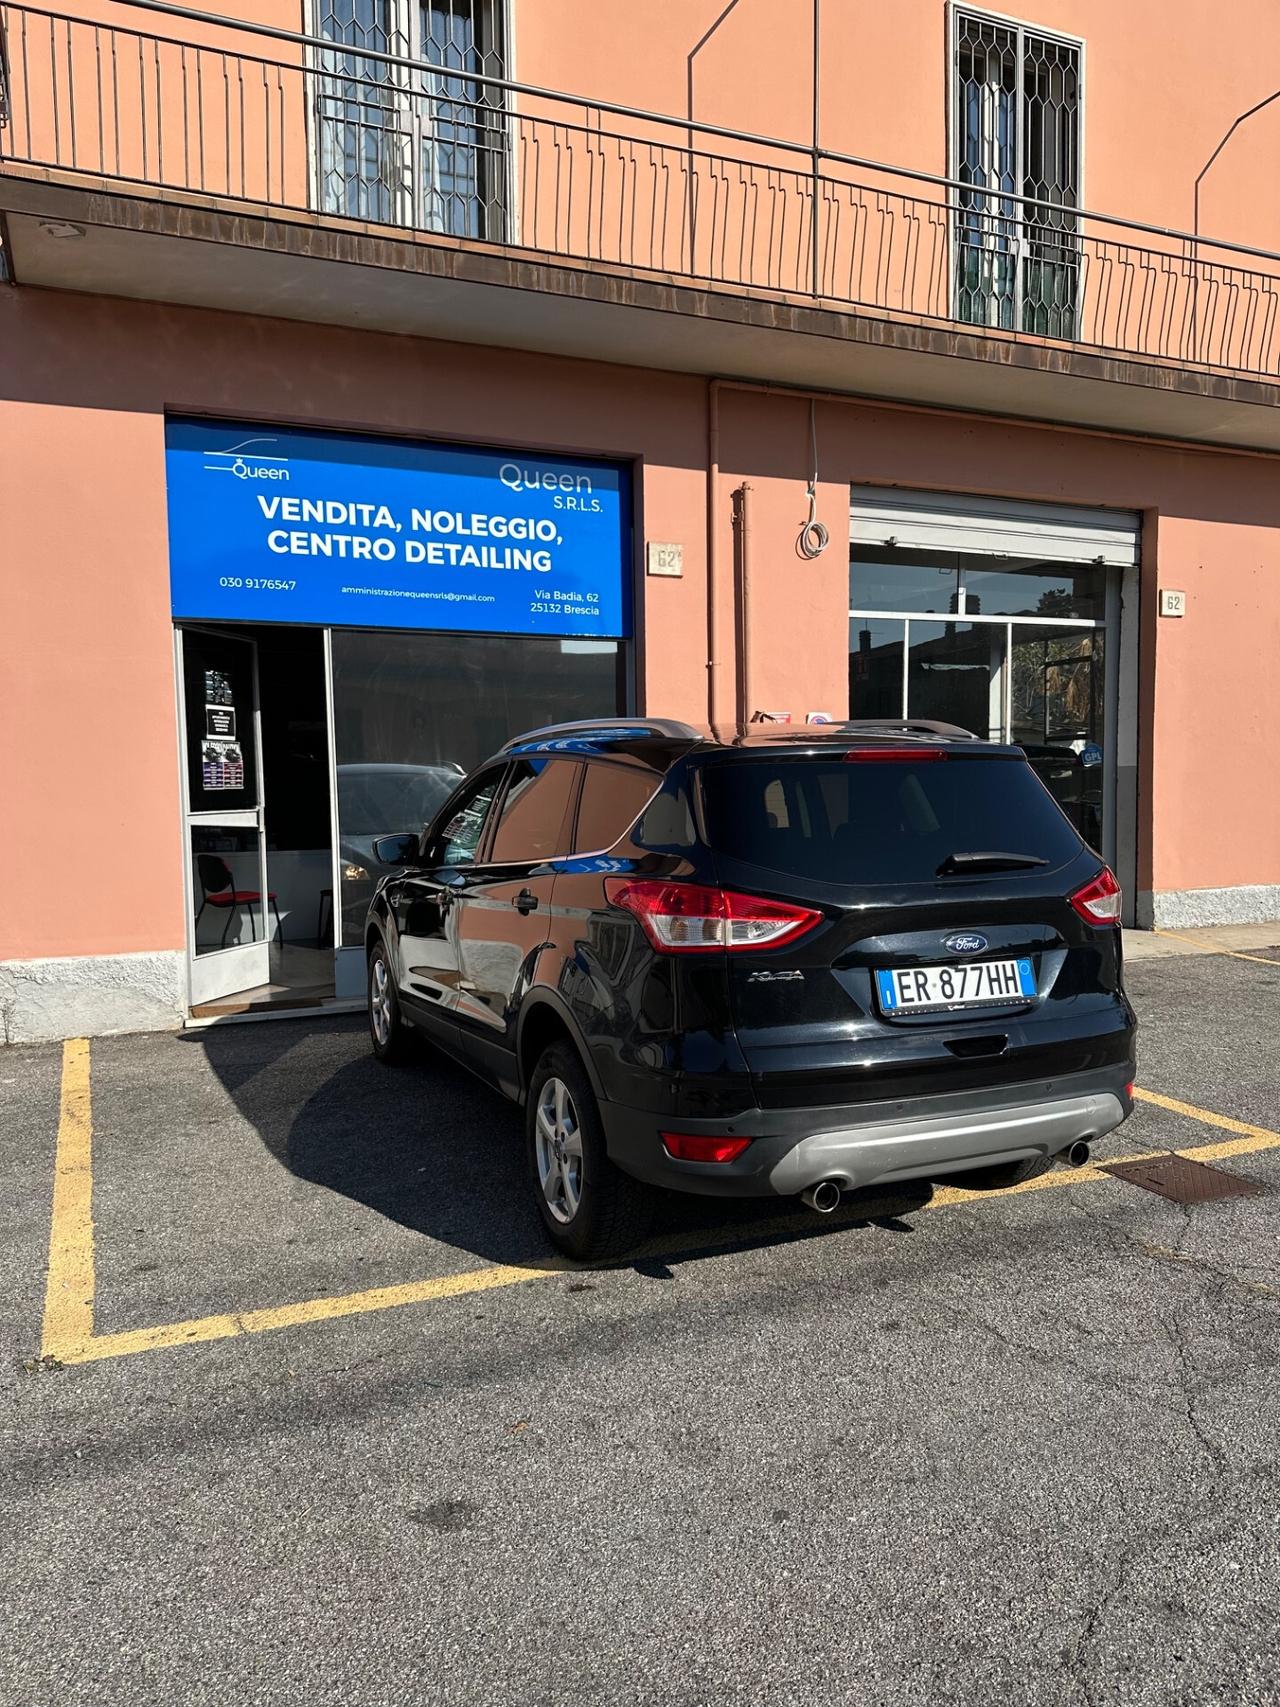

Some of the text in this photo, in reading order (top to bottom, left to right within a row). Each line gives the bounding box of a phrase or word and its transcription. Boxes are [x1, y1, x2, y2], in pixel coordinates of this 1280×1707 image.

[232, 462, 290, 480] Queen
[499, 463, 592, 494] Queen
[553, 495, 603, 513] S.R.L.S.
[257, 495, 563, 545] VENDITA, NOLEGGIO,
[267, 530, 552, 572] CENTRO DETAILING
[219, 576, 296, 591] 030 9176547
[341, 585, 496, 602] amministrazionequeensrls@gmail.com
[534, 589, 599, 603] Via Badia, 62
[530, 602, 600, 616] 25132 Brescia
[1167, 595, 1180, 610] 62
[1084, 751, 1102, 762] GPL
[955, 937, 980, 950] Ford
[896, 970, 932, 1004] ER
[939, 962, 1019, 1000] 877HH
